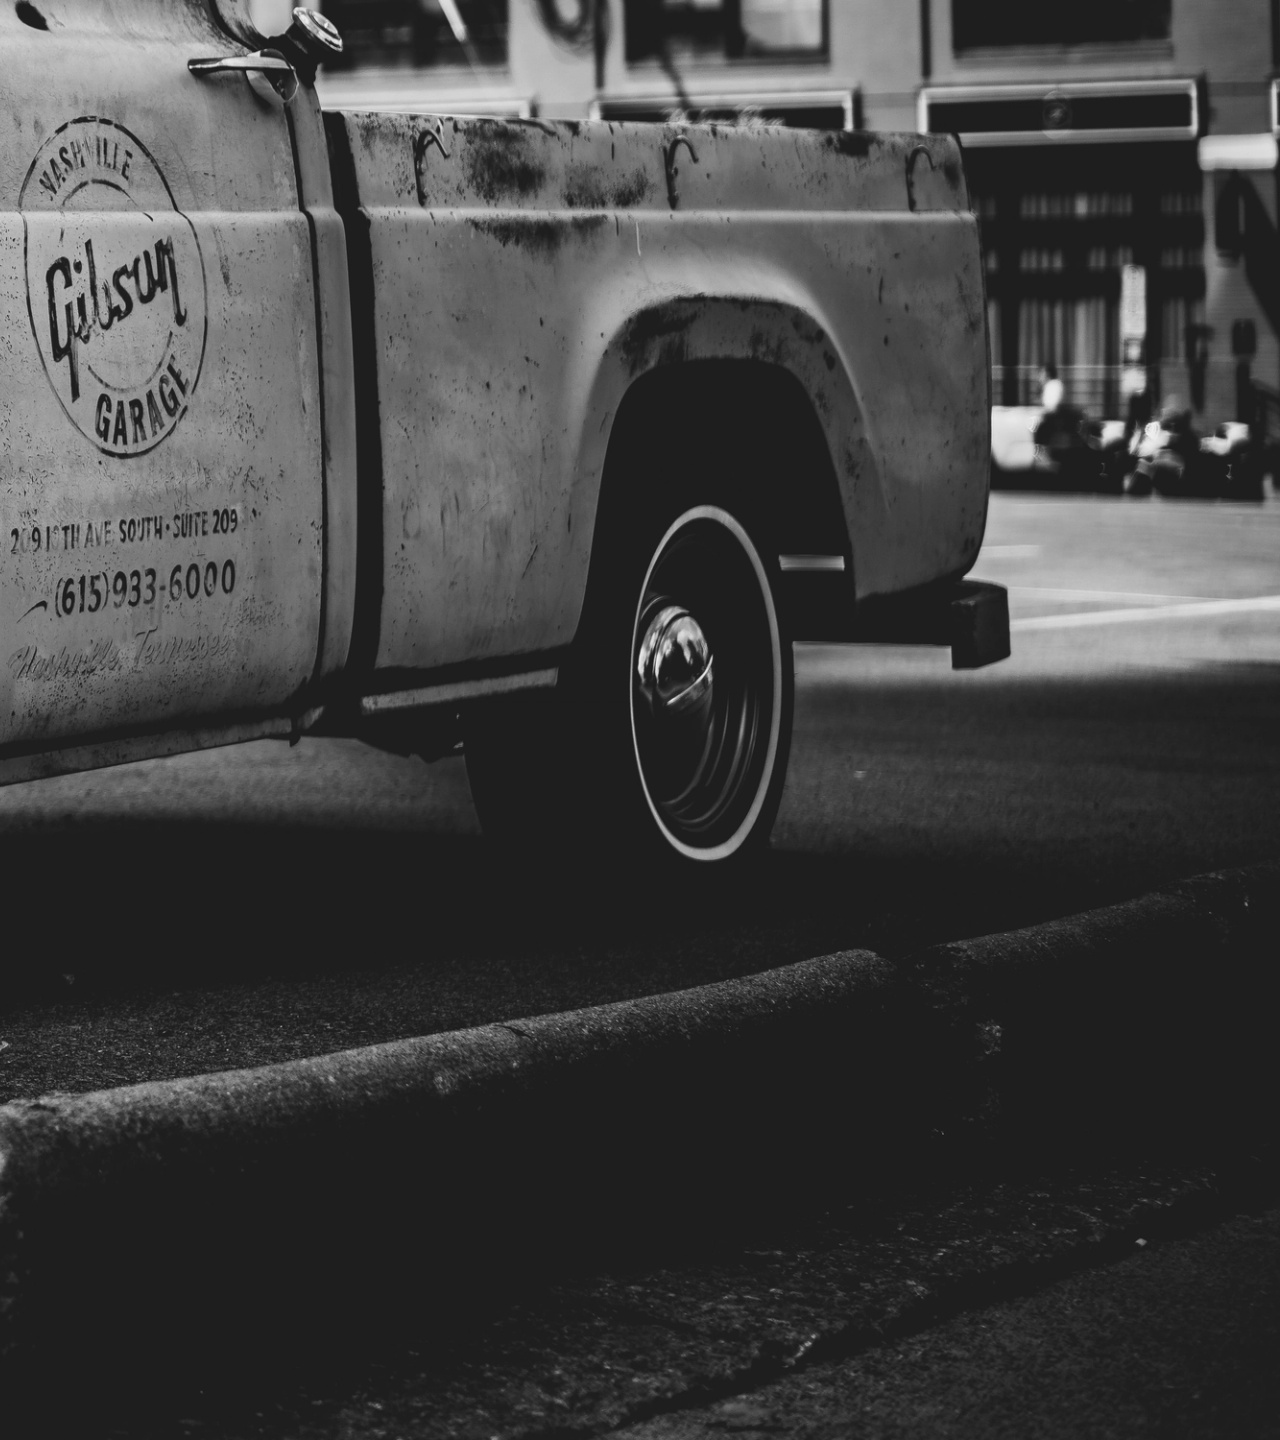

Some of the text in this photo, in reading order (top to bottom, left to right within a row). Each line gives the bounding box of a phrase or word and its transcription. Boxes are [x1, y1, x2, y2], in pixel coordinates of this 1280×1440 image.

[45, 236, 187, 402] Gibson
[94, 353, 190, 446] GARAGE
[10, 526, 42, 555] 209
[84, 519, 112, 549] AVE
[118, 514, 163, 544] SOUTH
[172, 510, 209, 539] SUITE
[212, 508, 238, 535] 209
